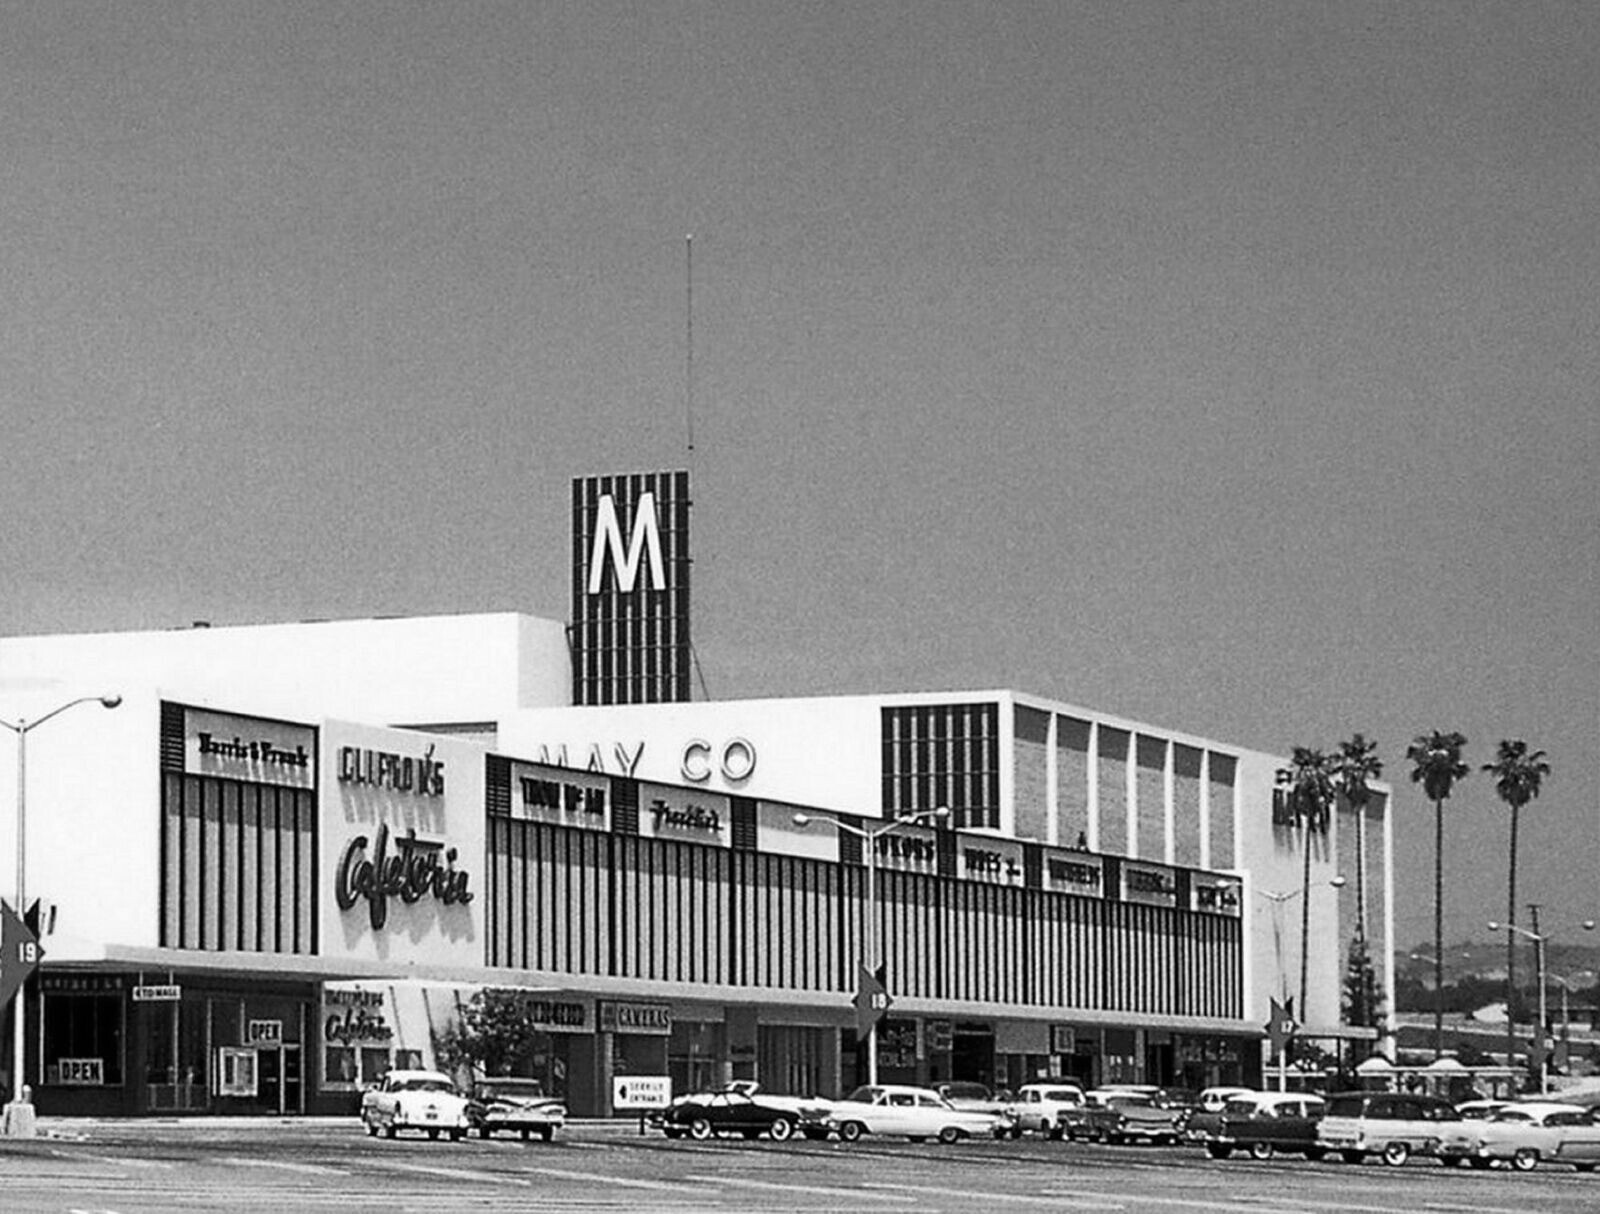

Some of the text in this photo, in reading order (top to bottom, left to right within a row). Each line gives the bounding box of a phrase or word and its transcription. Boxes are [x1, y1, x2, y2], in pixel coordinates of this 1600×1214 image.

[588, 492, 666, 594] M
[681, 737, 757, 782] CO
[335, 823, 475, 931] Cafeteria
[19, 942, 37, 962] 19
[251, 1022, 280, 1041] OPEN
[62, 1062, 102, 1082] OPEN
